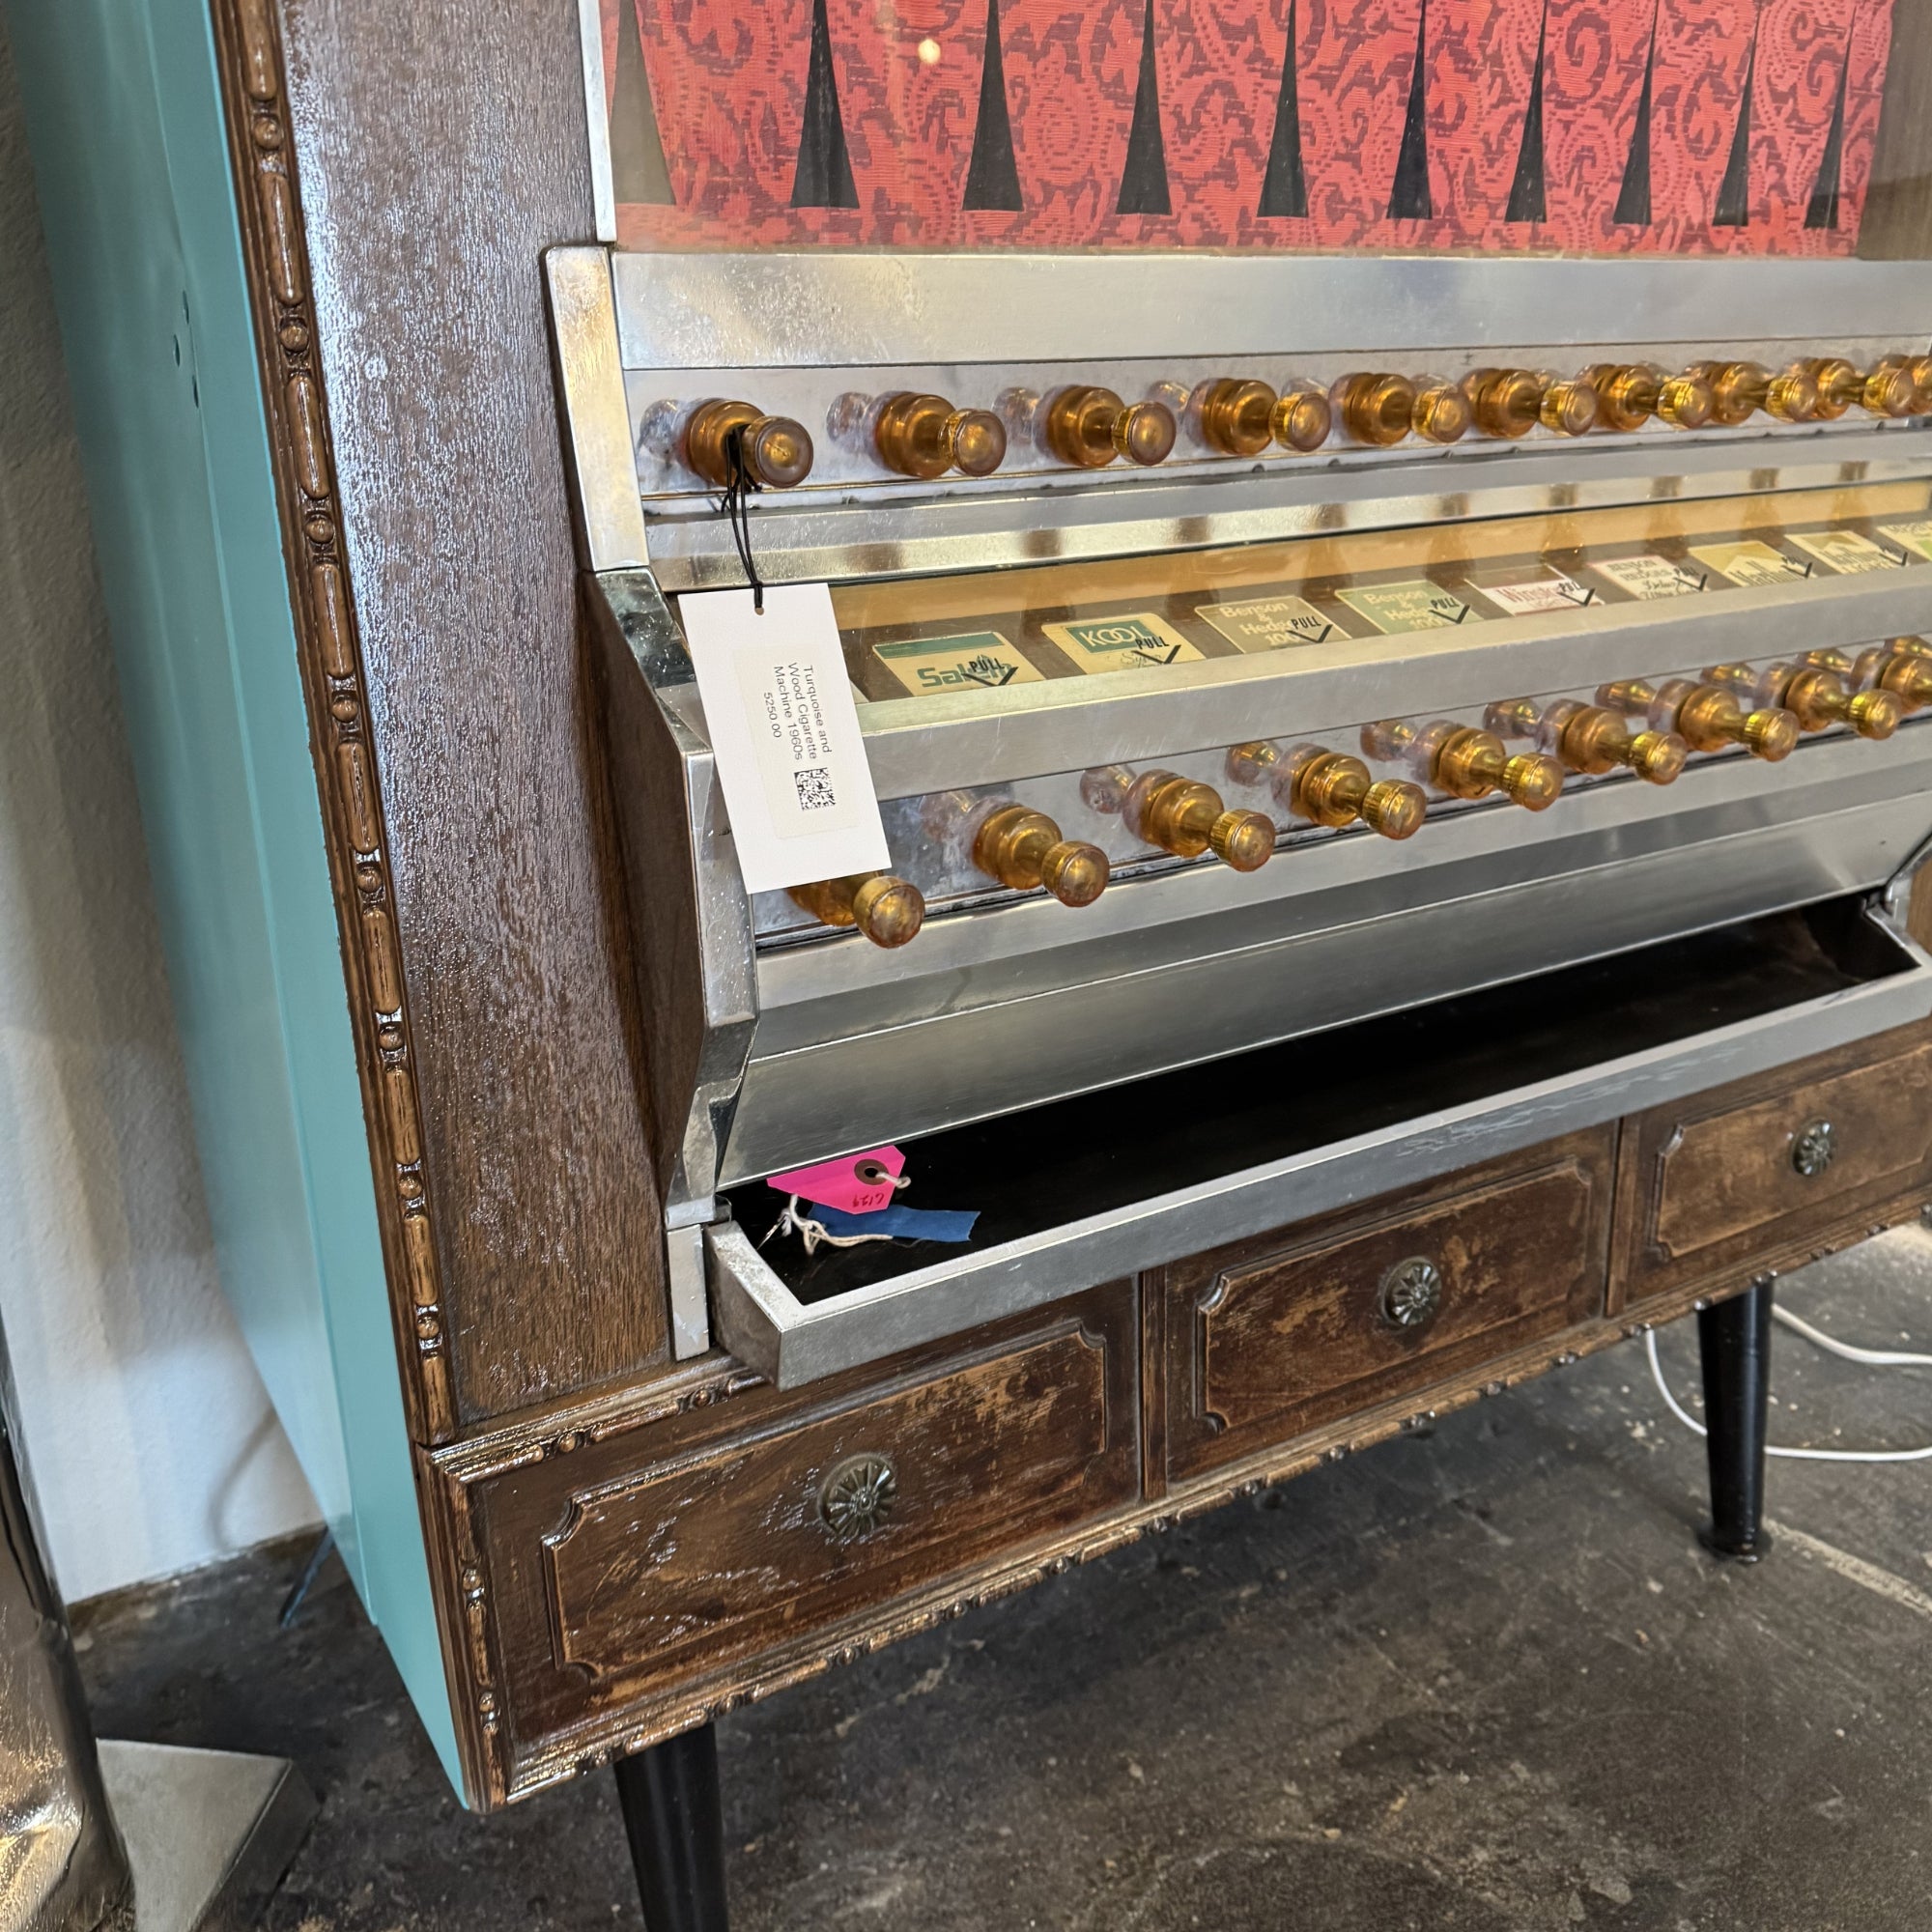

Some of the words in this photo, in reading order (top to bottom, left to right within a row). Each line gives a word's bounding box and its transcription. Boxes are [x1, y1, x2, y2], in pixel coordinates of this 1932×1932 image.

[1219, 601, 1290, 618] Benson
[1430, 597, 1461, 611] PULL
[1291, 615, 1322, 630] PULL
[1079, 625, 1151, 646] KOOL
[1135, 636, 1170, 650] PULL
[969, 657, 1006, 673] PULL
[774, 666, 792, 718] Machine
[787, 722, 803, 760] 1960s
[788, 662, 806, 700] Wood
[798, 703, 816, 759] Cigarette
[804, 665, 823, 726] Turquoise
[818, 730, 832, 753] and
